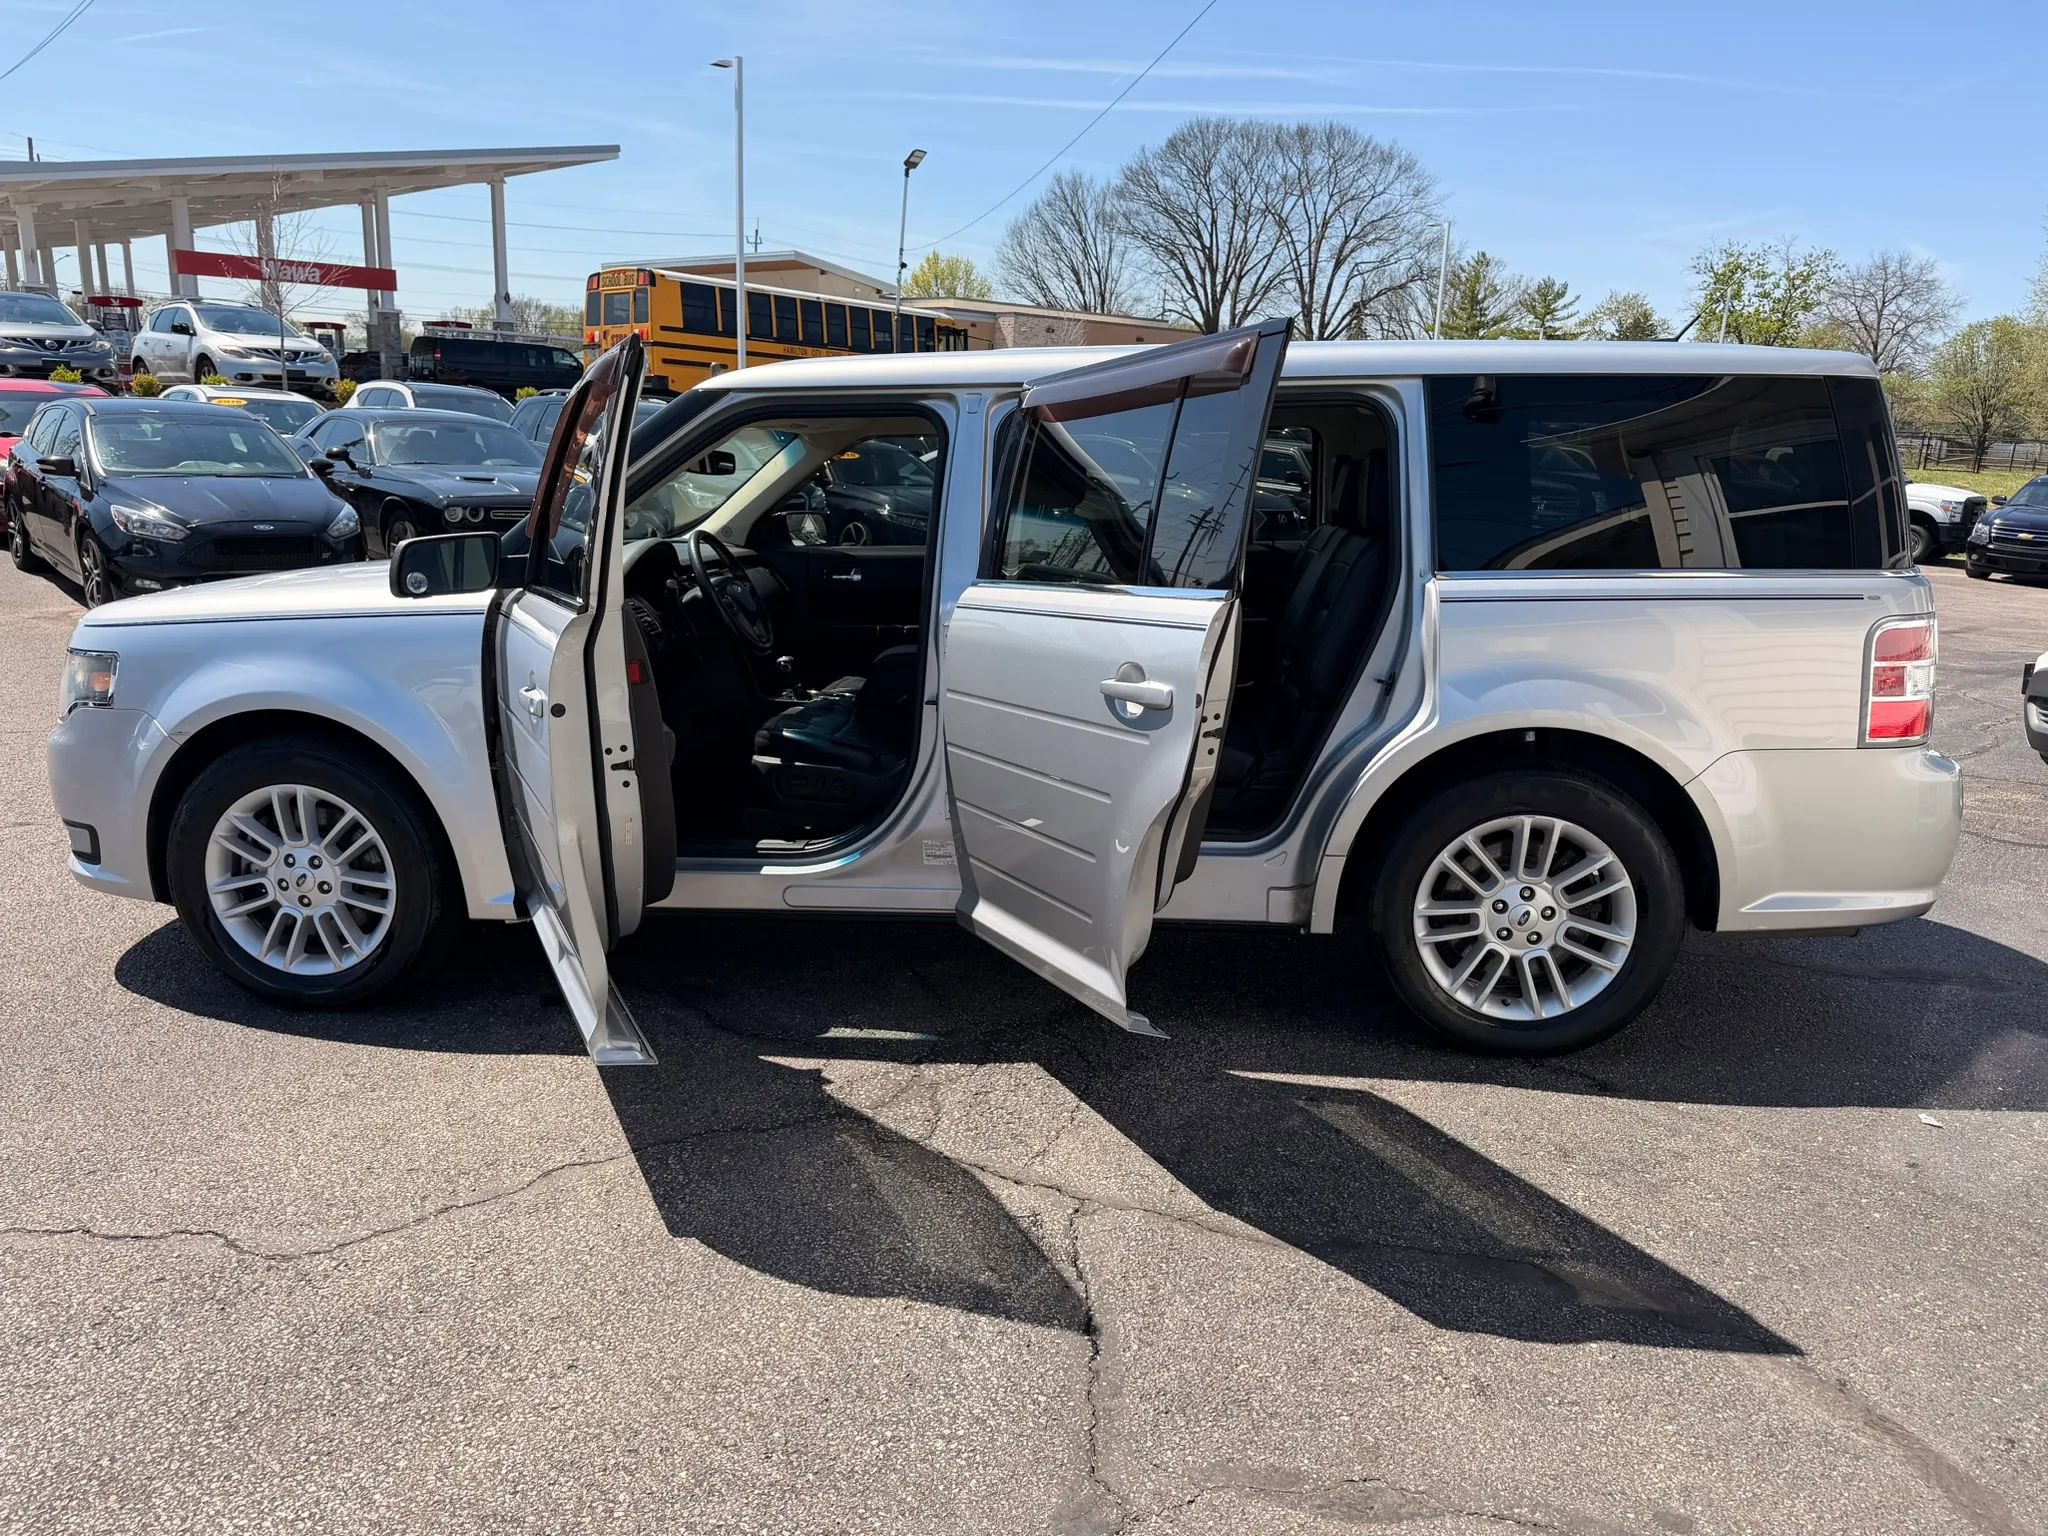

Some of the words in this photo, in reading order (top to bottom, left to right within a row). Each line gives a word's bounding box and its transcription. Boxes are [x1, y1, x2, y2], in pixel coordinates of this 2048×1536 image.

[261, 260, 321, 282] Wawa
[601, 274, 624, 288] SCHOOL
[624, 273, 635, 287] BUS
